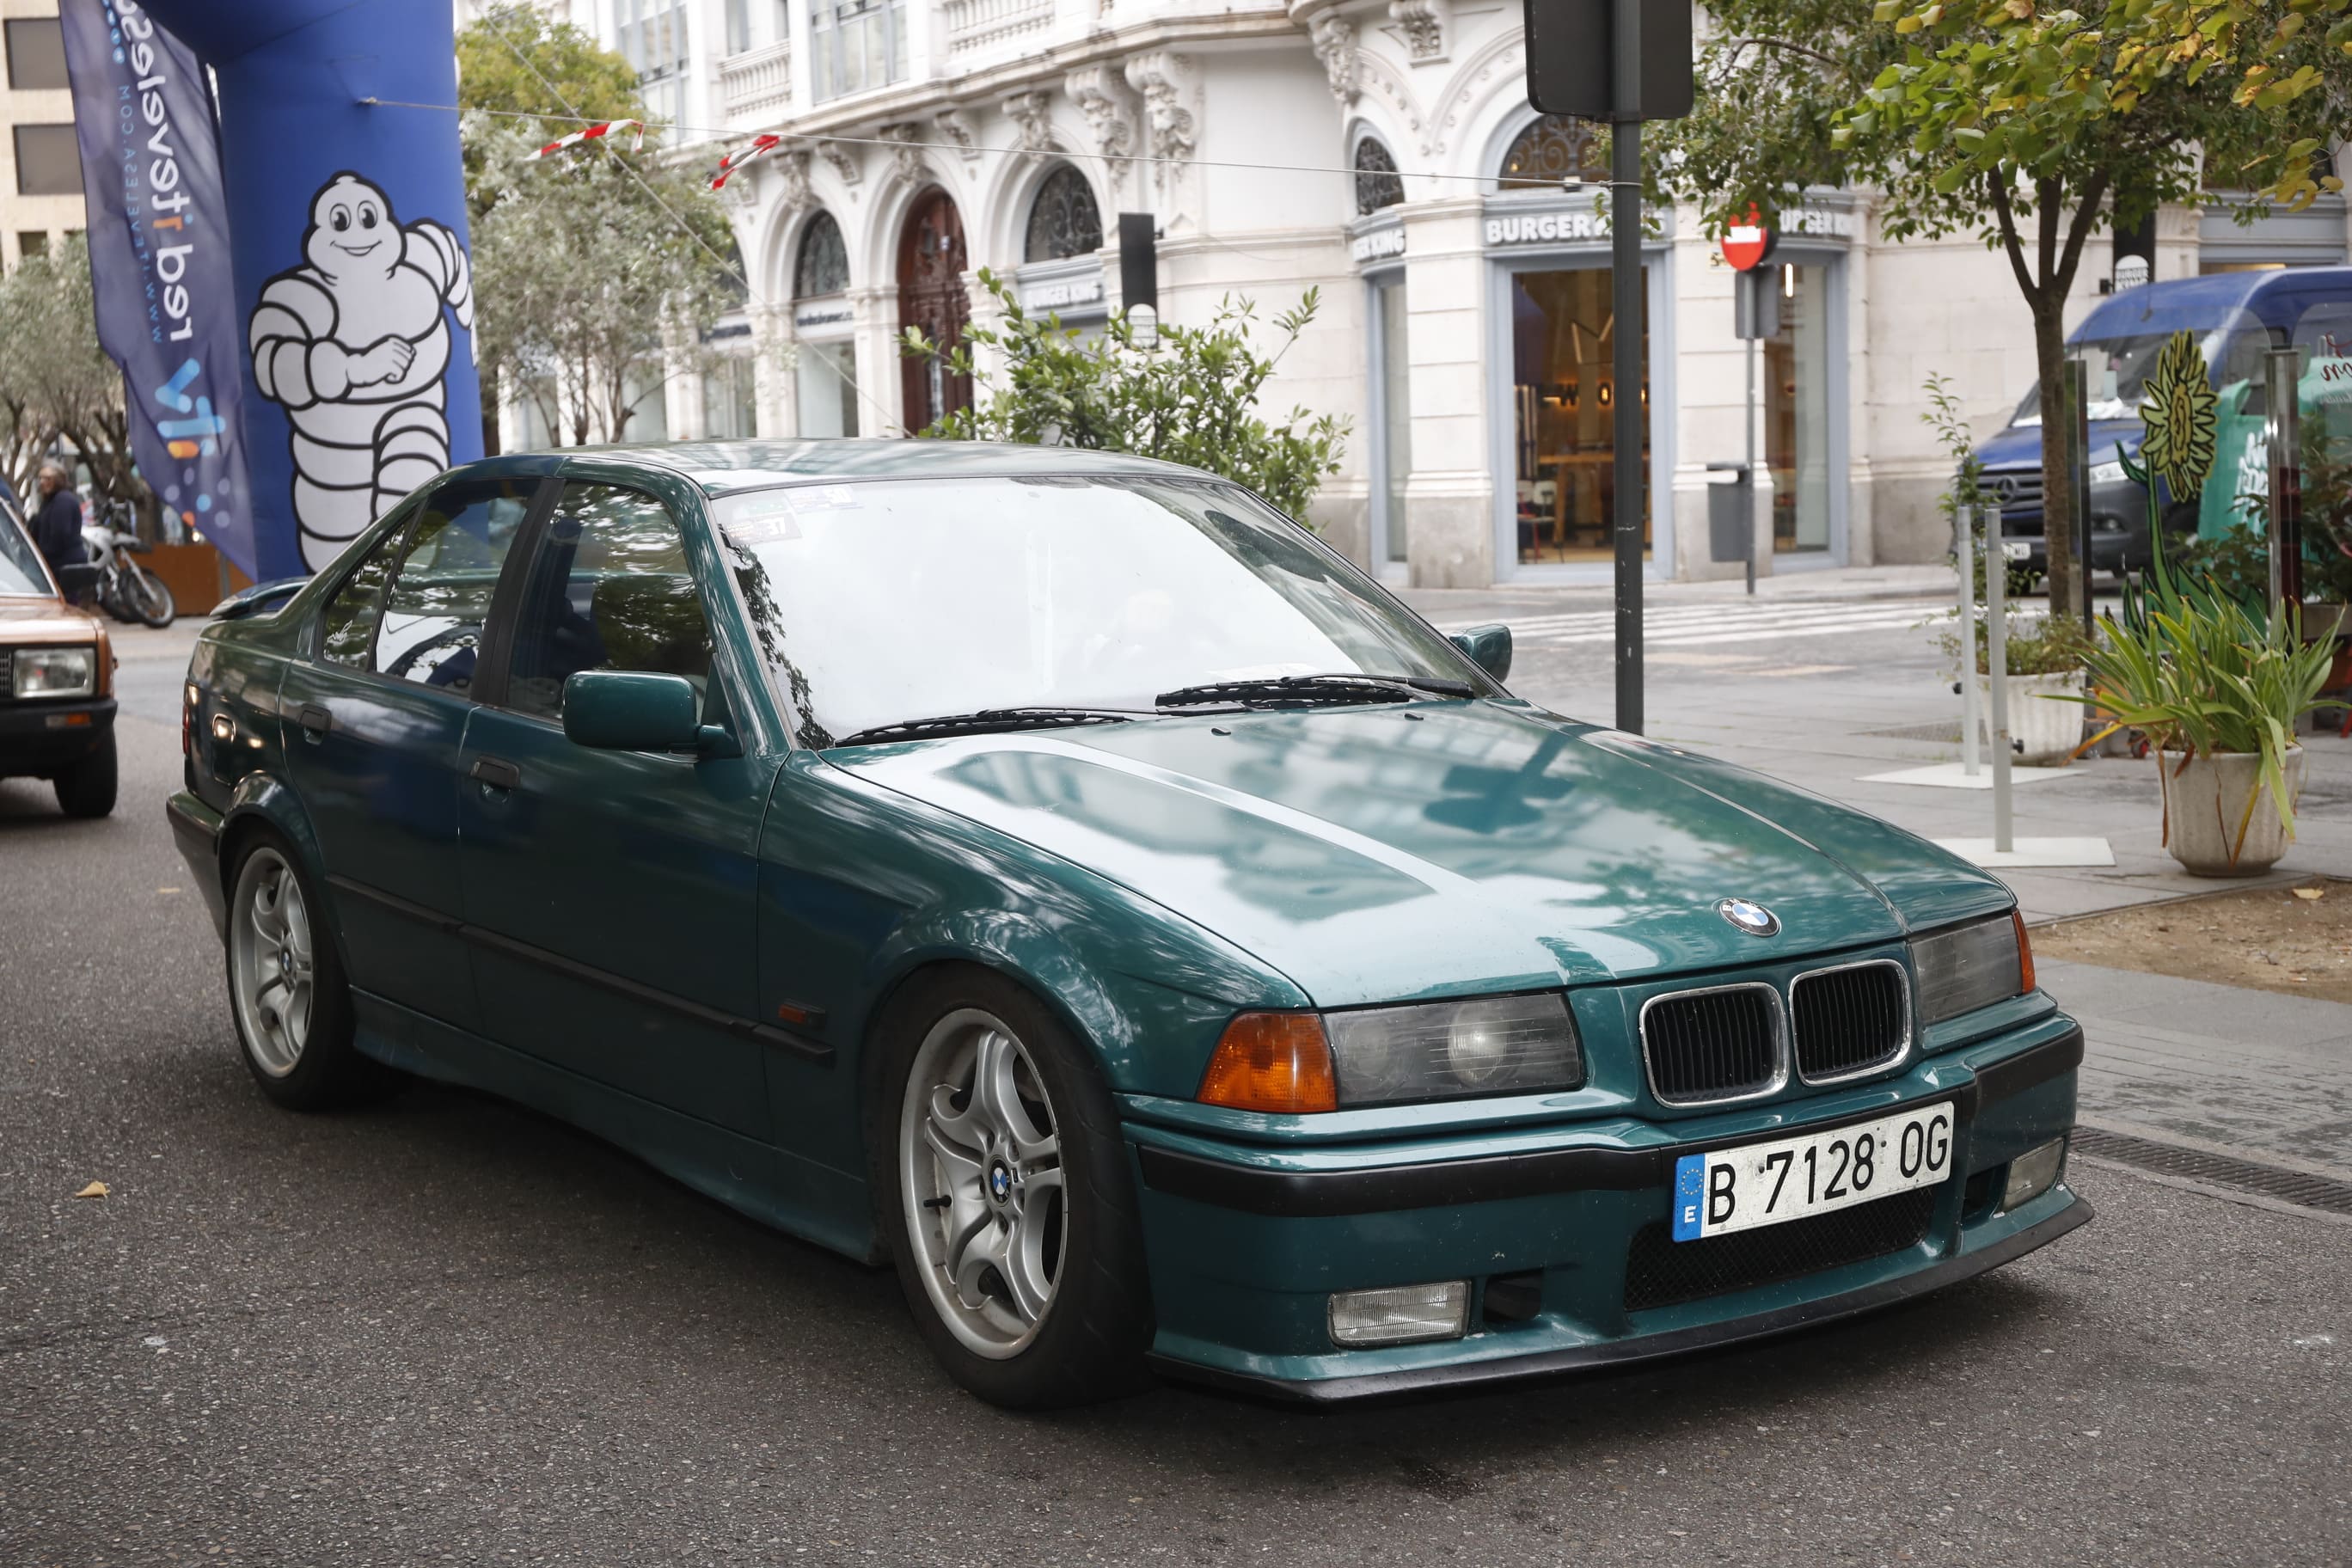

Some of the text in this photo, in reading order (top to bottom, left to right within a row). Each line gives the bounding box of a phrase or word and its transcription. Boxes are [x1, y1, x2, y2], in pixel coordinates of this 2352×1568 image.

[1486, 215, 1590, 244] BURGER
[1708, 1114, 1949, 1226] B 7128 OG
[1684, 1205, 1697, 1223] E
